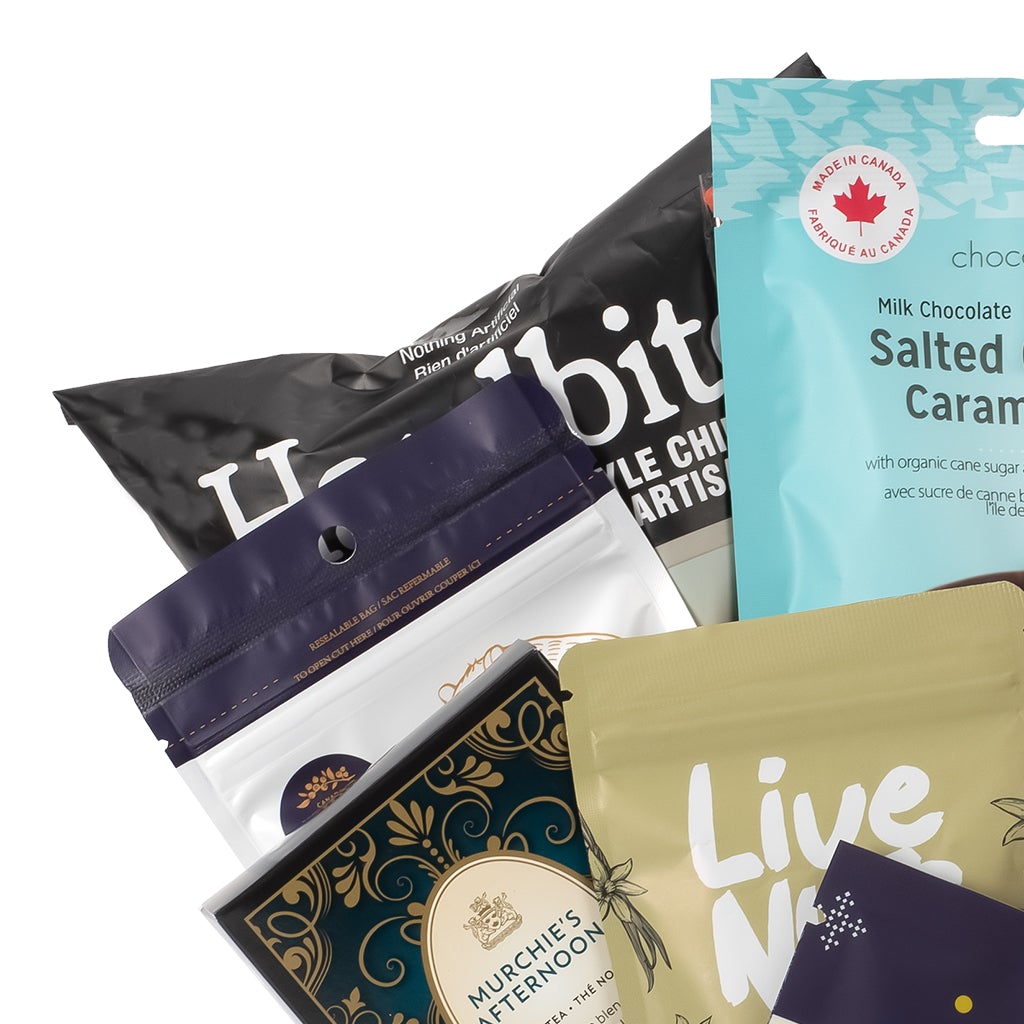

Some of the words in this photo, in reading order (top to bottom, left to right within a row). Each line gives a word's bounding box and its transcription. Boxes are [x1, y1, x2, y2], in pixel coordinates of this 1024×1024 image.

[812, 159, 842, 191] MADE
[843, 155, 857, 166] IN
[861, 155, 906, 190] CANADA
[808, 209, 856, 256] FABRIQUÉ
[860, 248, 876, 258] AU
[881, 207, 915, 254] CANADA
[399, 333, 466, 365] Nothing
[471, 283, 520, 337] Artificial
[878, 297, 913, 316] Milk
[920, 300, 1012, 320] Chocolate
[414, 356, 451, 380] Rien
[870, 328, 1003, 374] Salted
[666, 418, 728, 469] CHI
[865, 454, 895, 471] with
[897, 455, 948, 472] organic
[950, 459, 981, 472] cane
[984, 461, 1020, 477] sugar
[631, 457, 731, 527] ARTIS
[884, 485, 916, 499] avec
[918, 487, 954, 499] sucre
[956, 485, 974, 500] de
[976, 489, 1016, 503] canne
[293, 668, 308, 682] TO
[307, 654, 332, 674] OPEN
[330, 644, 350, 660] CUT
[350, 629, 372, 648] HERE
[376, 611, 402, 631] POUR
[401, 591, 436, 614] OUVRIR
[434, 569, 470, 593] COUPER
[468, 559, 482, 572] ICI
[309, 616, 361, 652] RESEALABLE
[359, 604, 378, 622] BAG
[381, 590, 399, 606] SAC
[399, 556, 452, 596] REFERMABLE
[688, 756, 945, 889] Live
[467, 909, 582, 1010] MURCHIE'S
[573, 983, 597, 1006] THÉ
